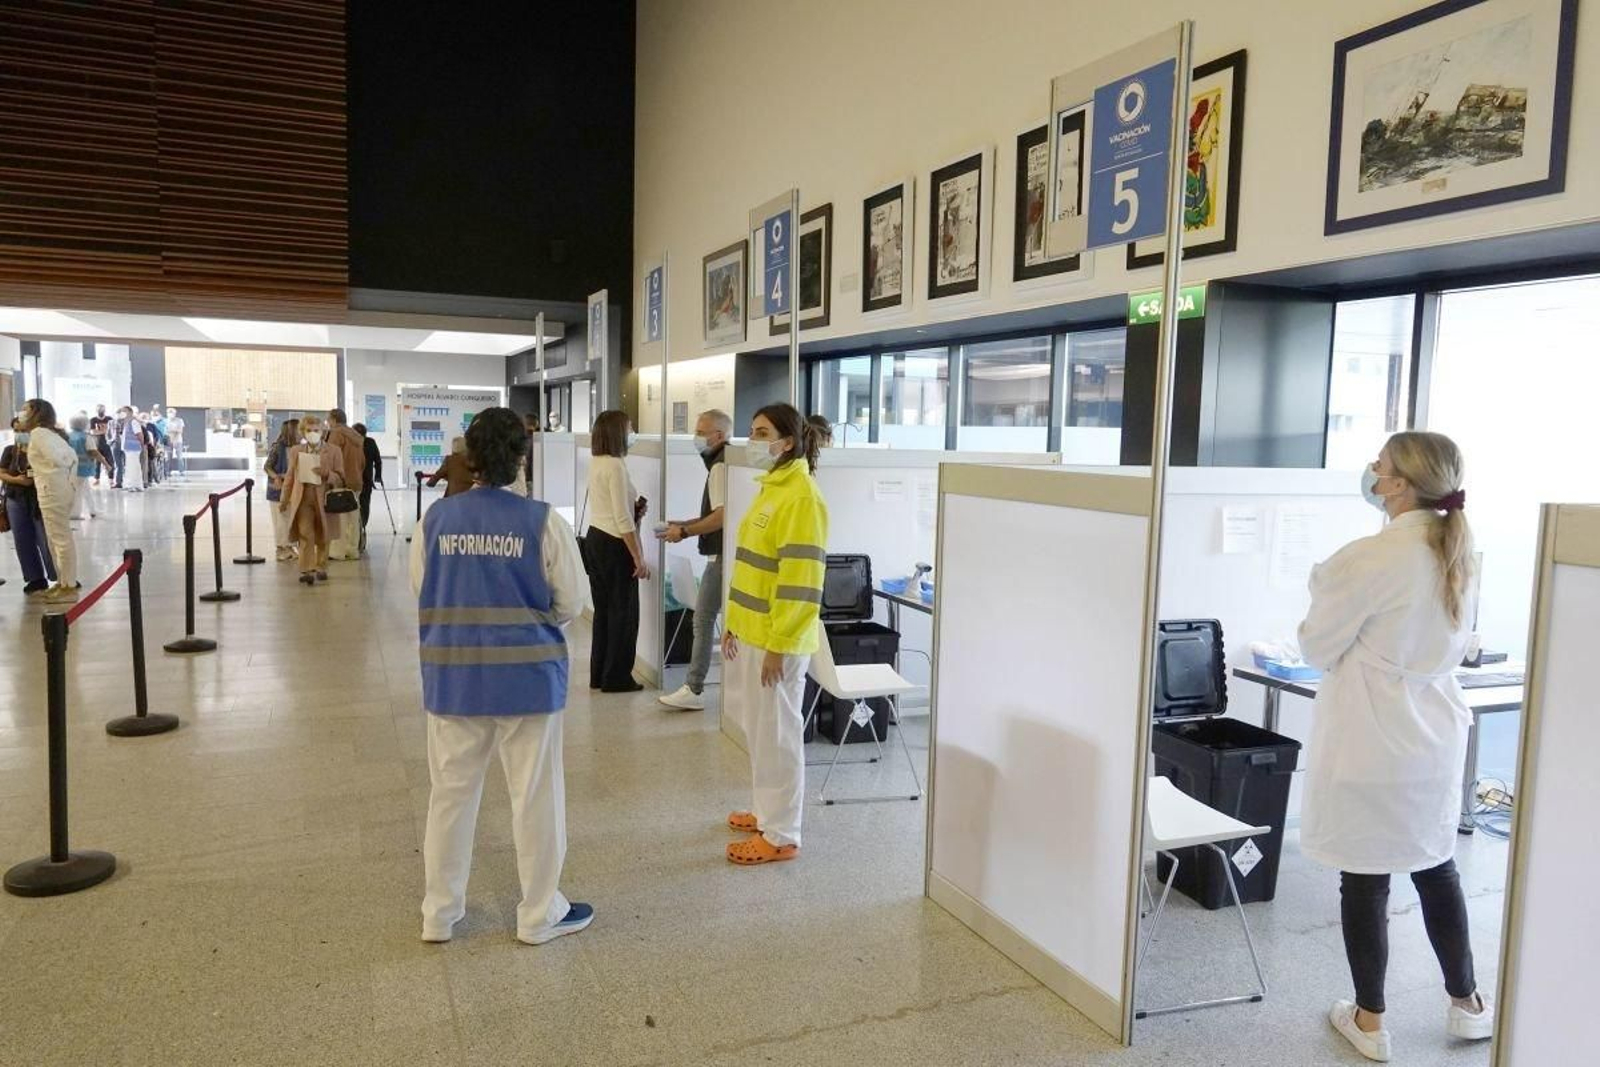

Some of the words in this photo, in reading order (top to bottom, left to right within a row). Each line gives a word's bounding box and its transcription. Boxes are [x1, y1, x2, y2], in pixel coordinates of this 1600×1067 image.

[1111, 167, 1139, 234] 5
[771, 270, 783, 308] 4
[652, 308, 658, 337] 3
[438, 531, 524, 558] INFORMACIÓN
